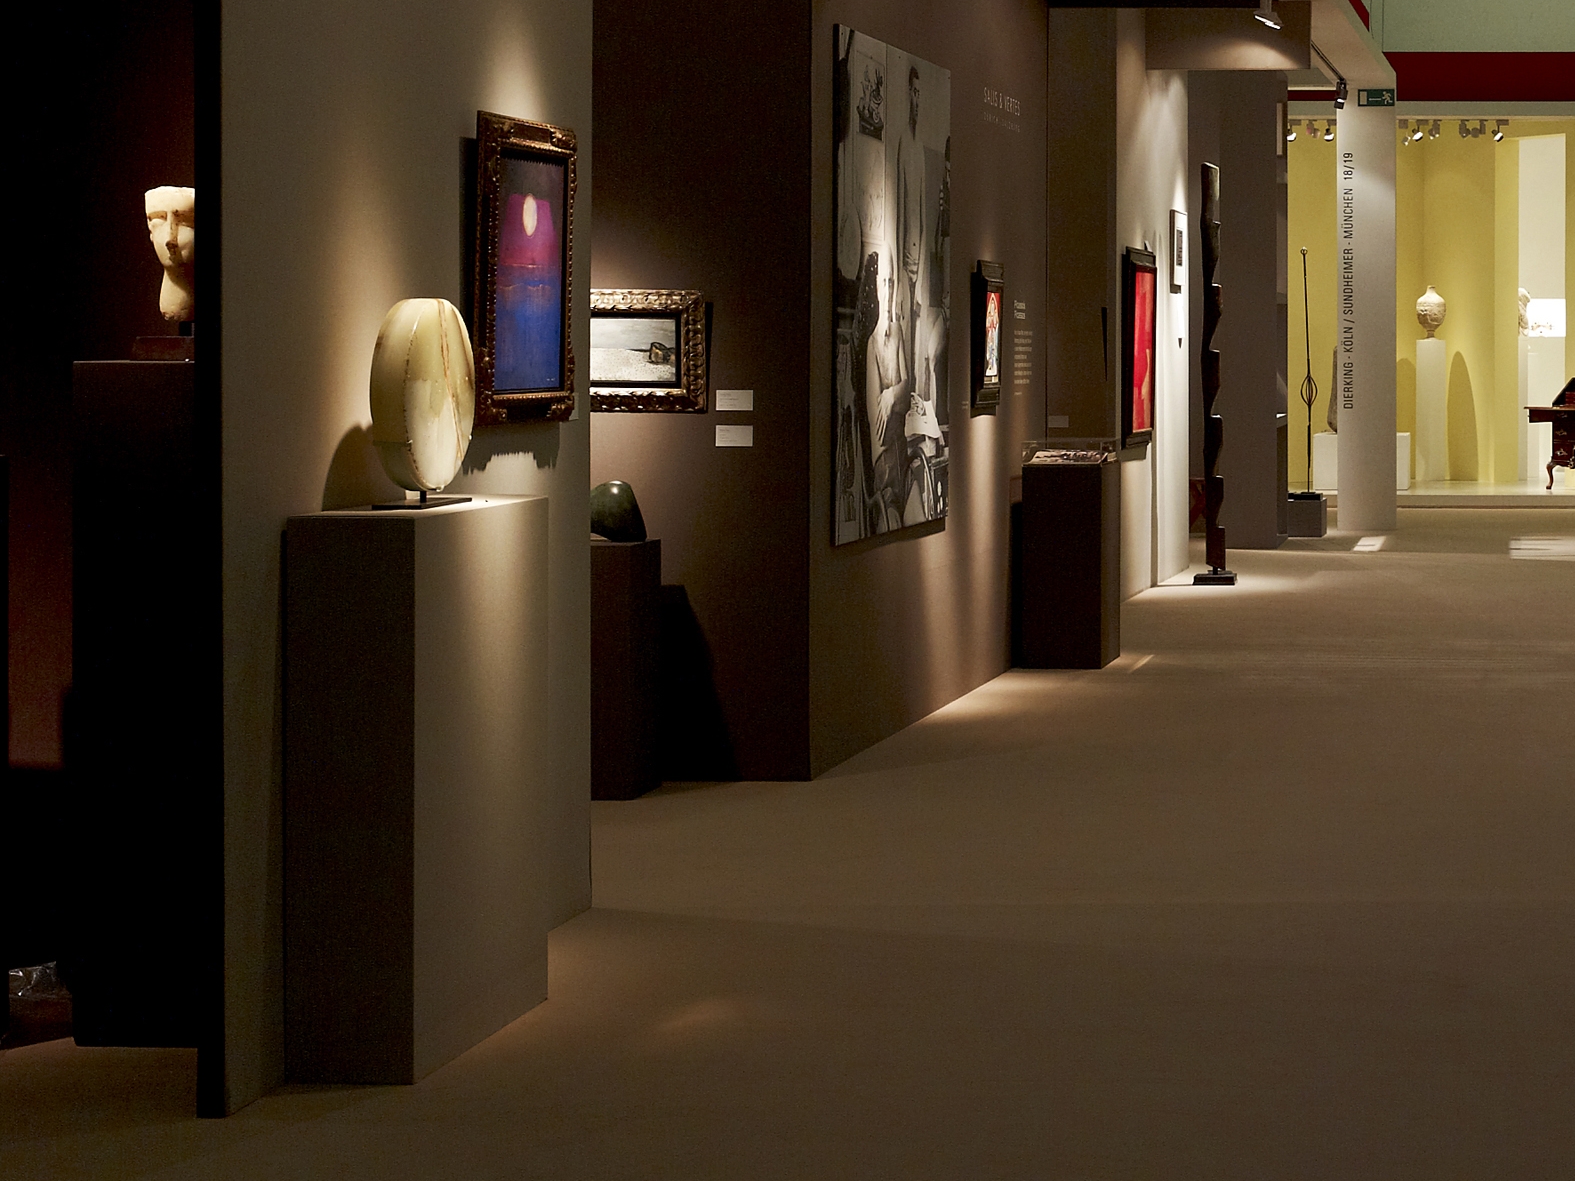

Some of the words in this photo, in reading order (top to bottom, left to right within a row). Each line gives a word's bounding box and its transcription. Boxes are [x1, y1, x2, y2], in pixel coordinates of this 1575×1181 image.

[1342, 152, 1355, 181] 18/19
[1340, 188, 1354, 239] MÜNCHEN
[1342, 248, 1354, 316] SUNDHEIMER
[1340, 327, 1354, 353] KÖLN
[1342, 362, 1354, 410] DIERKING
